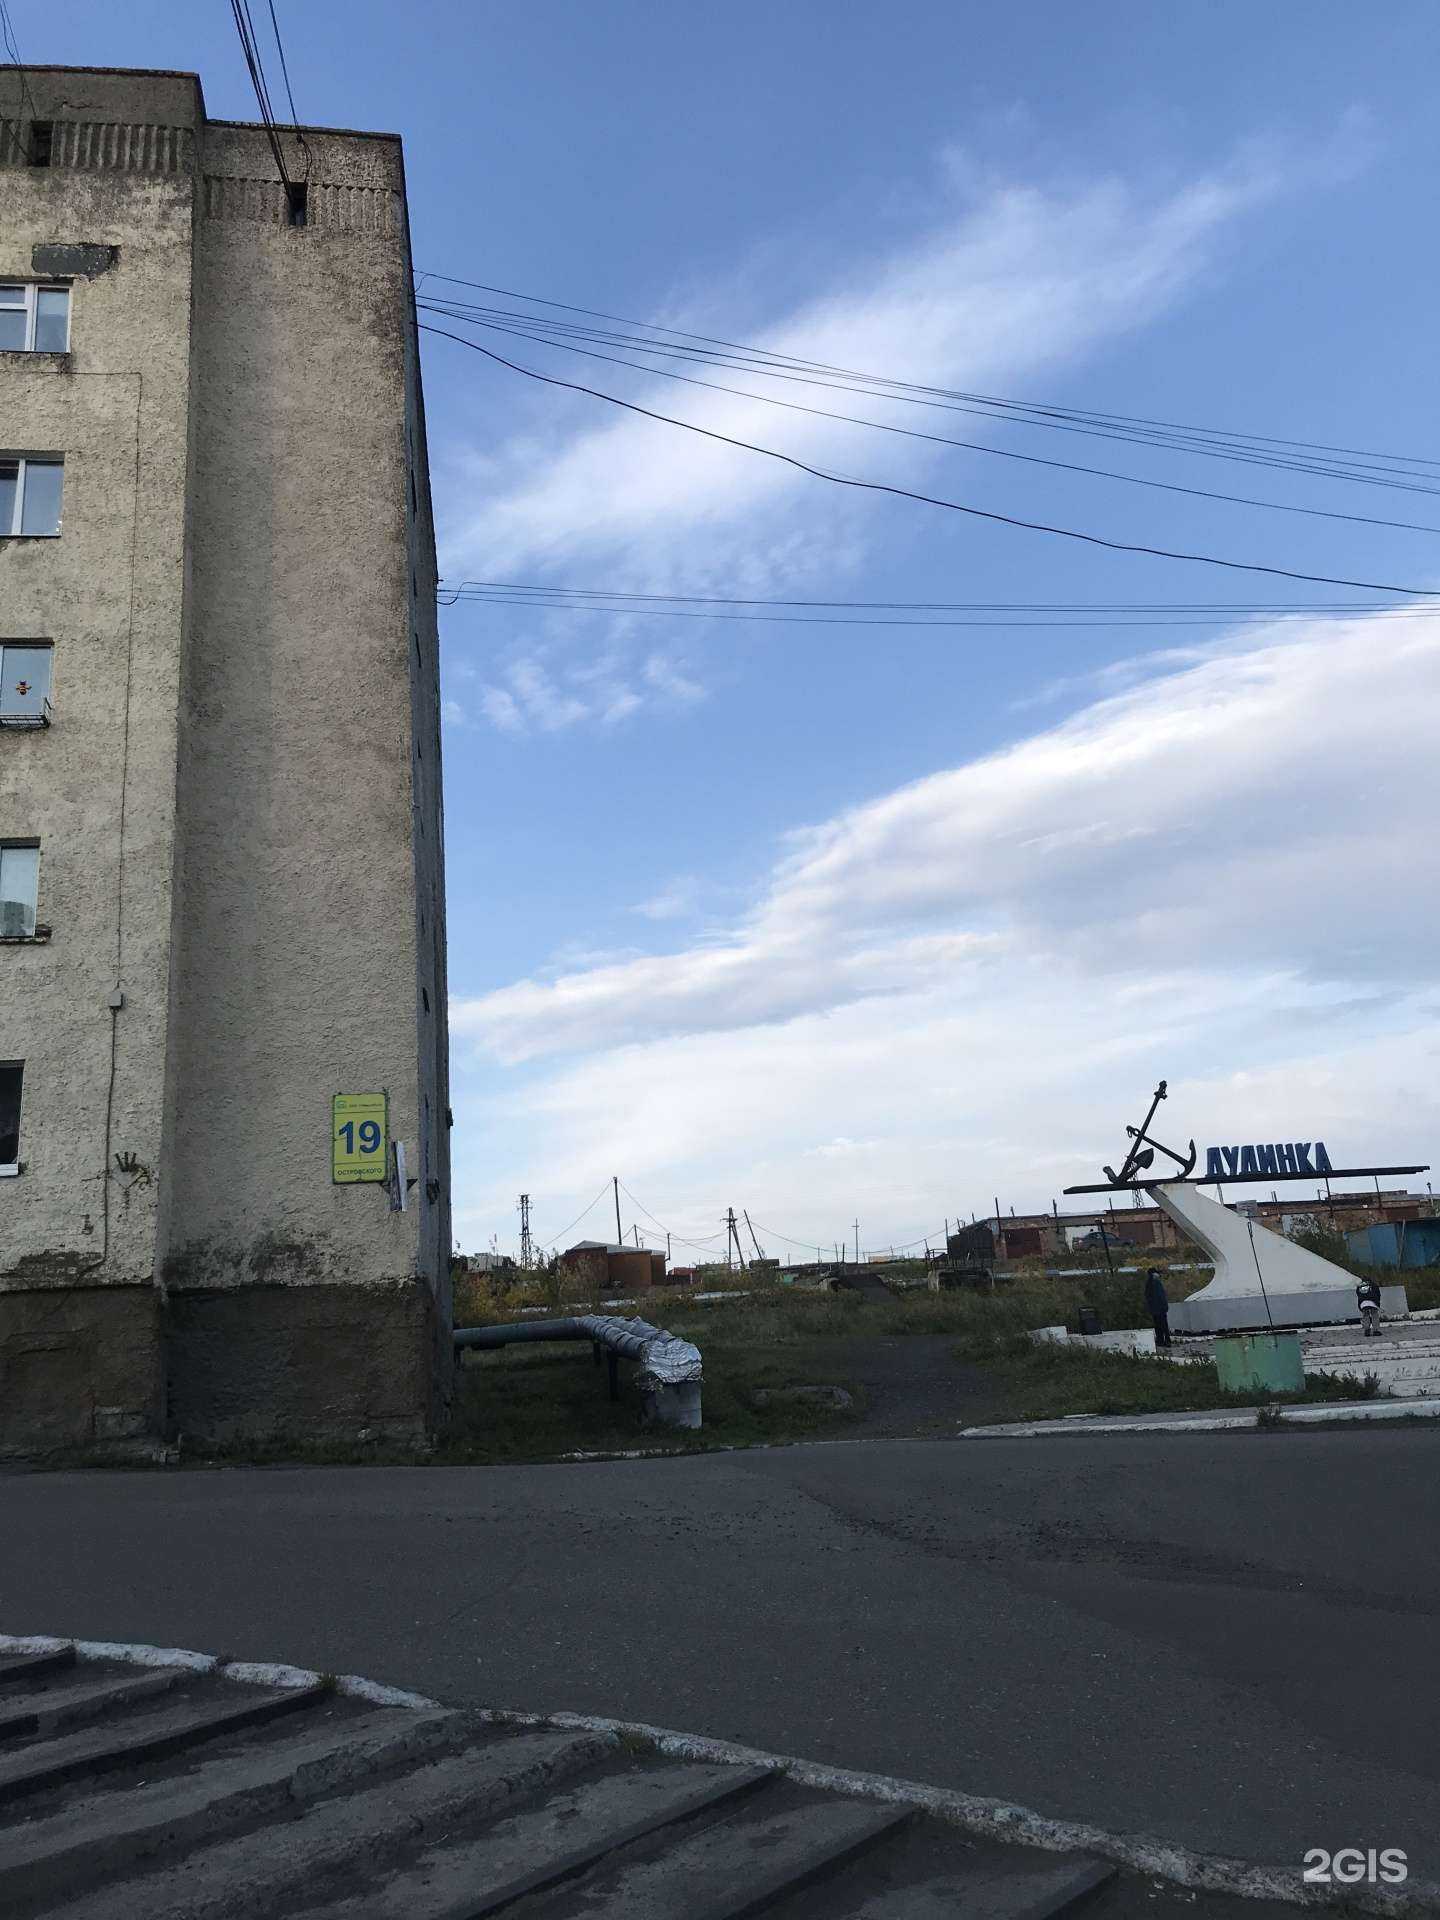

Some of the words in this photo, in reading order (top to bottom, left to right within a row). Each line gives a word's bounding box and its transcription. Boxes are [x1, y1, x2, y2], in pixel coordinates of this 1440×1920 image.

[339, 1120, 381, 1154] 19
[337, 1167, 382, 1176] ОСТРОВСКОГО
[1206, 1141, 1333, 1177] ДУДИНКА
